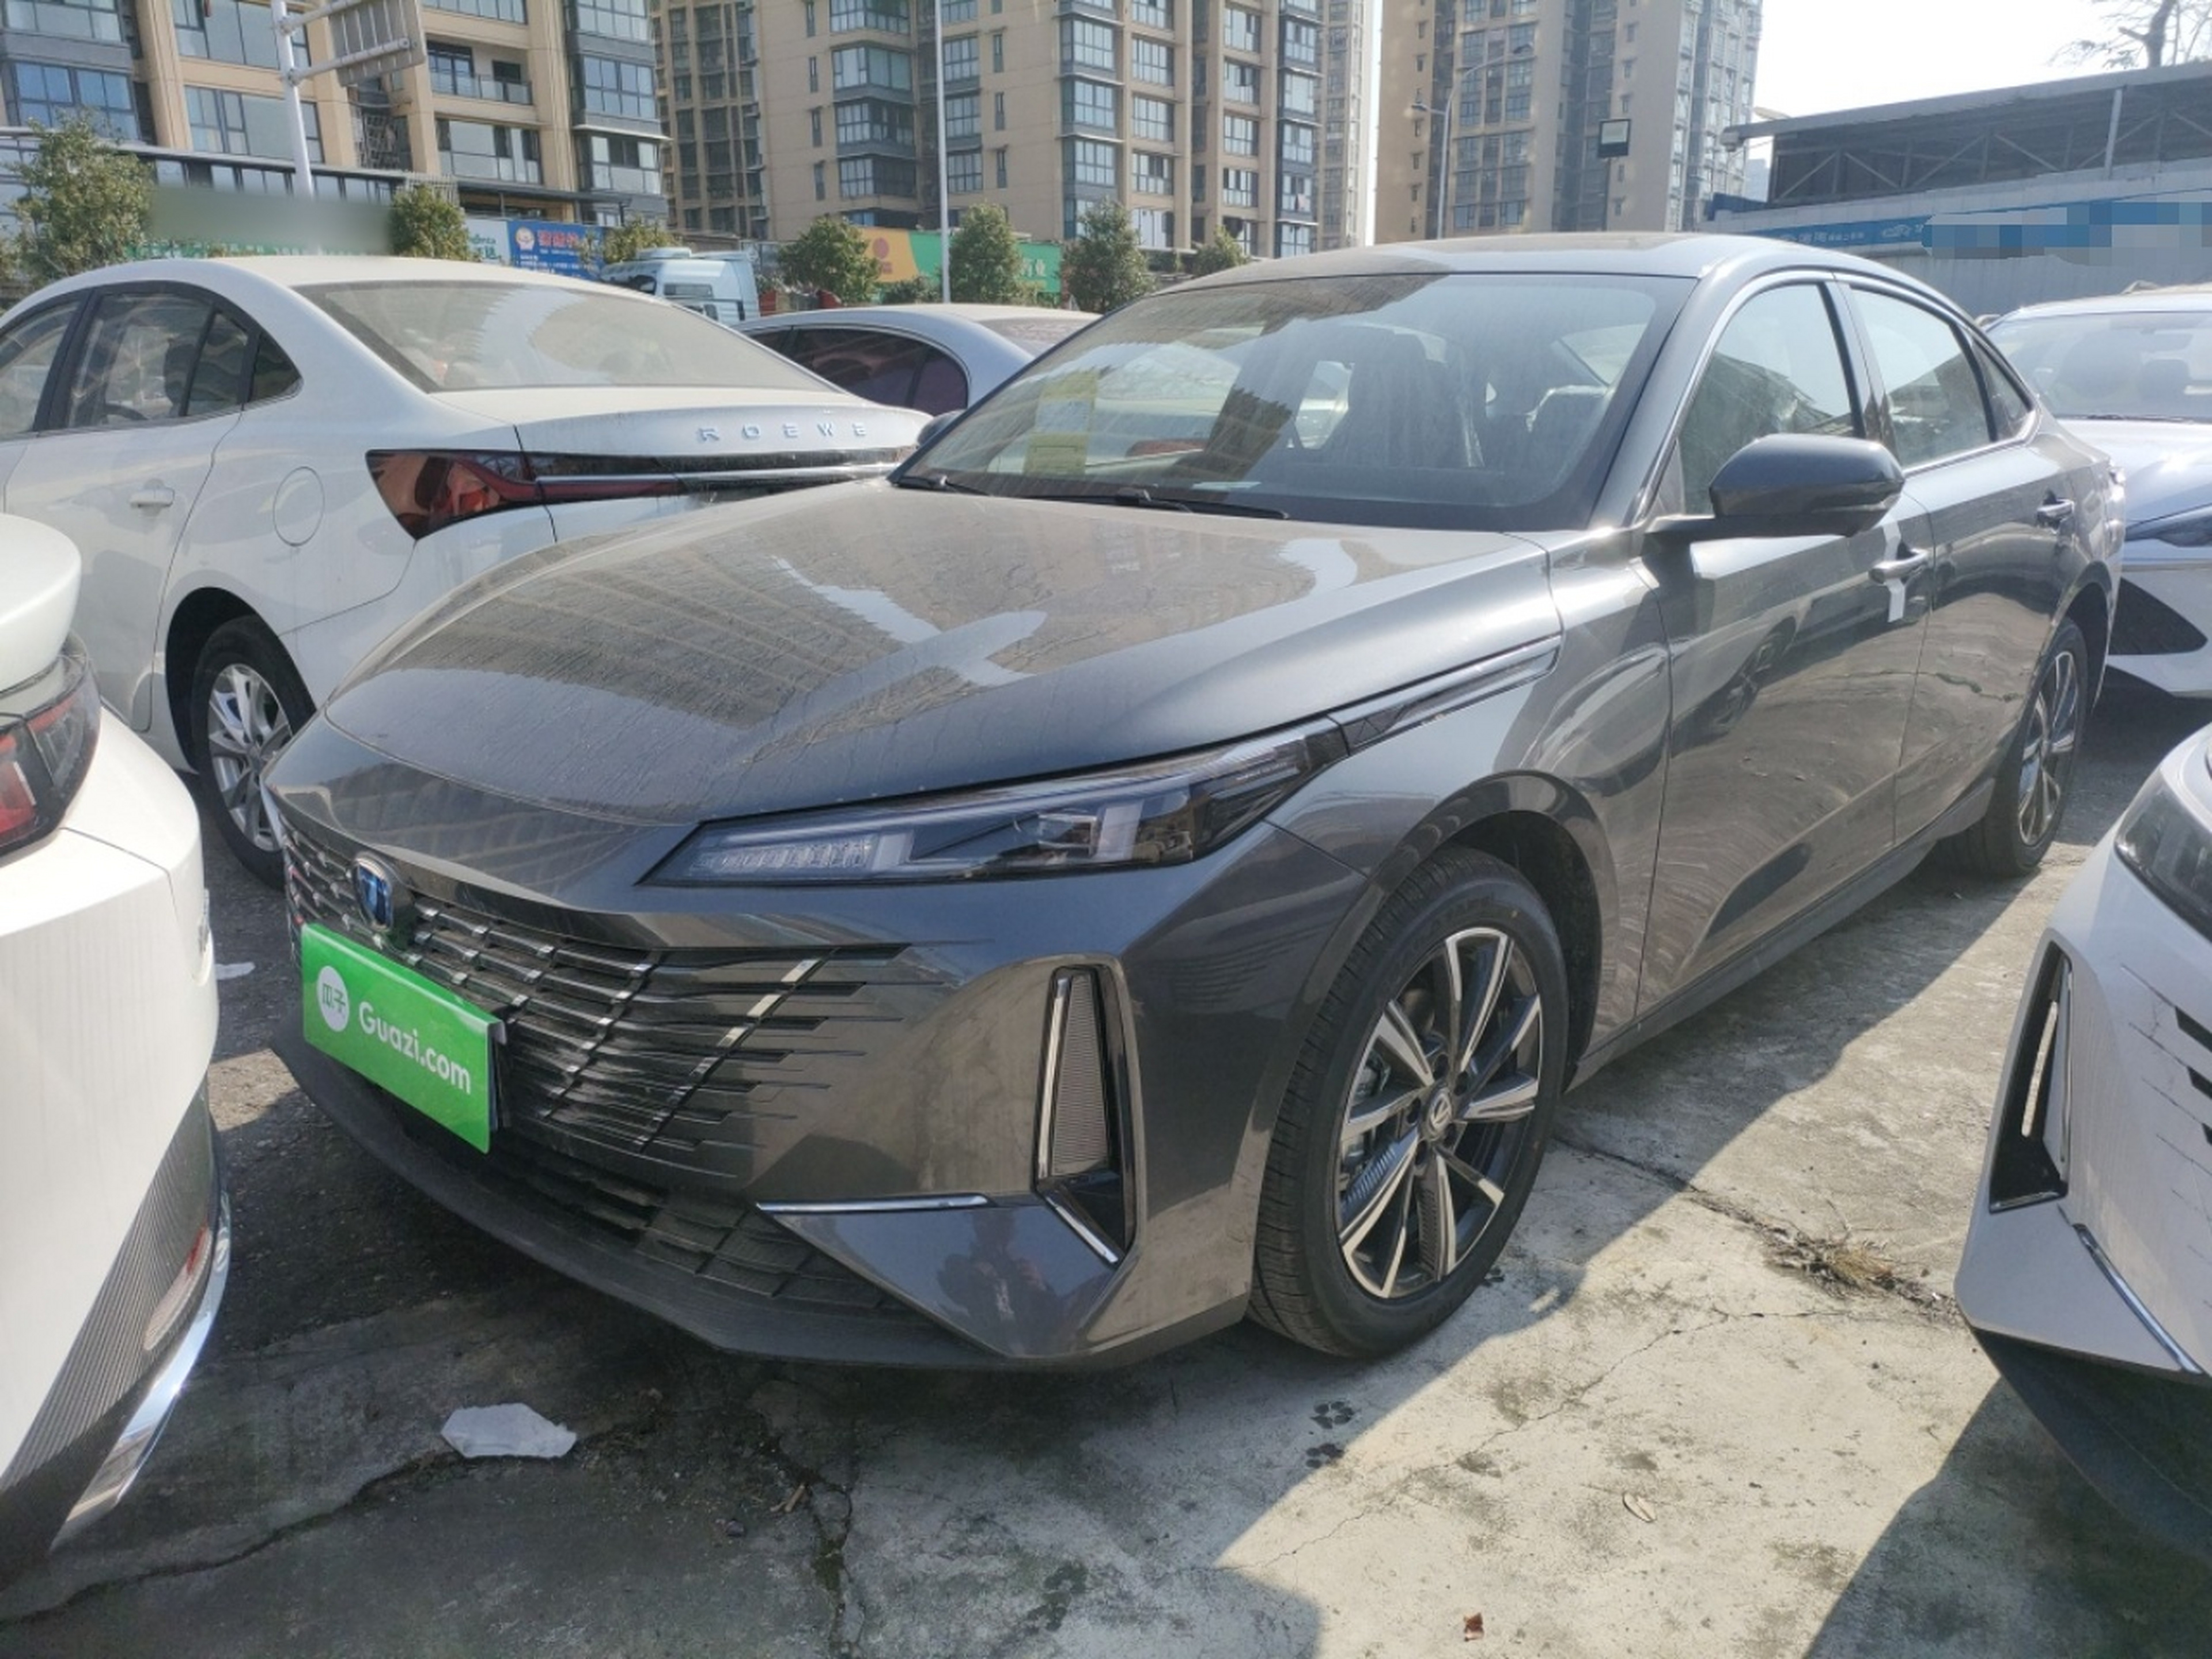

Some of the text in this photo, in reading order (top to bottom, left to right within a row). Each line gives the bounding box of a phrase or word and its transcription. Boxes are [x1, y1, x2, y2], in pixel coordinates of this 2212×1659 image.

[696, 422, 866, 442] ROEWE
[322, 983, 346, 1013] 瓜子
[359, 1001, 470, 1094] Guazi.com
